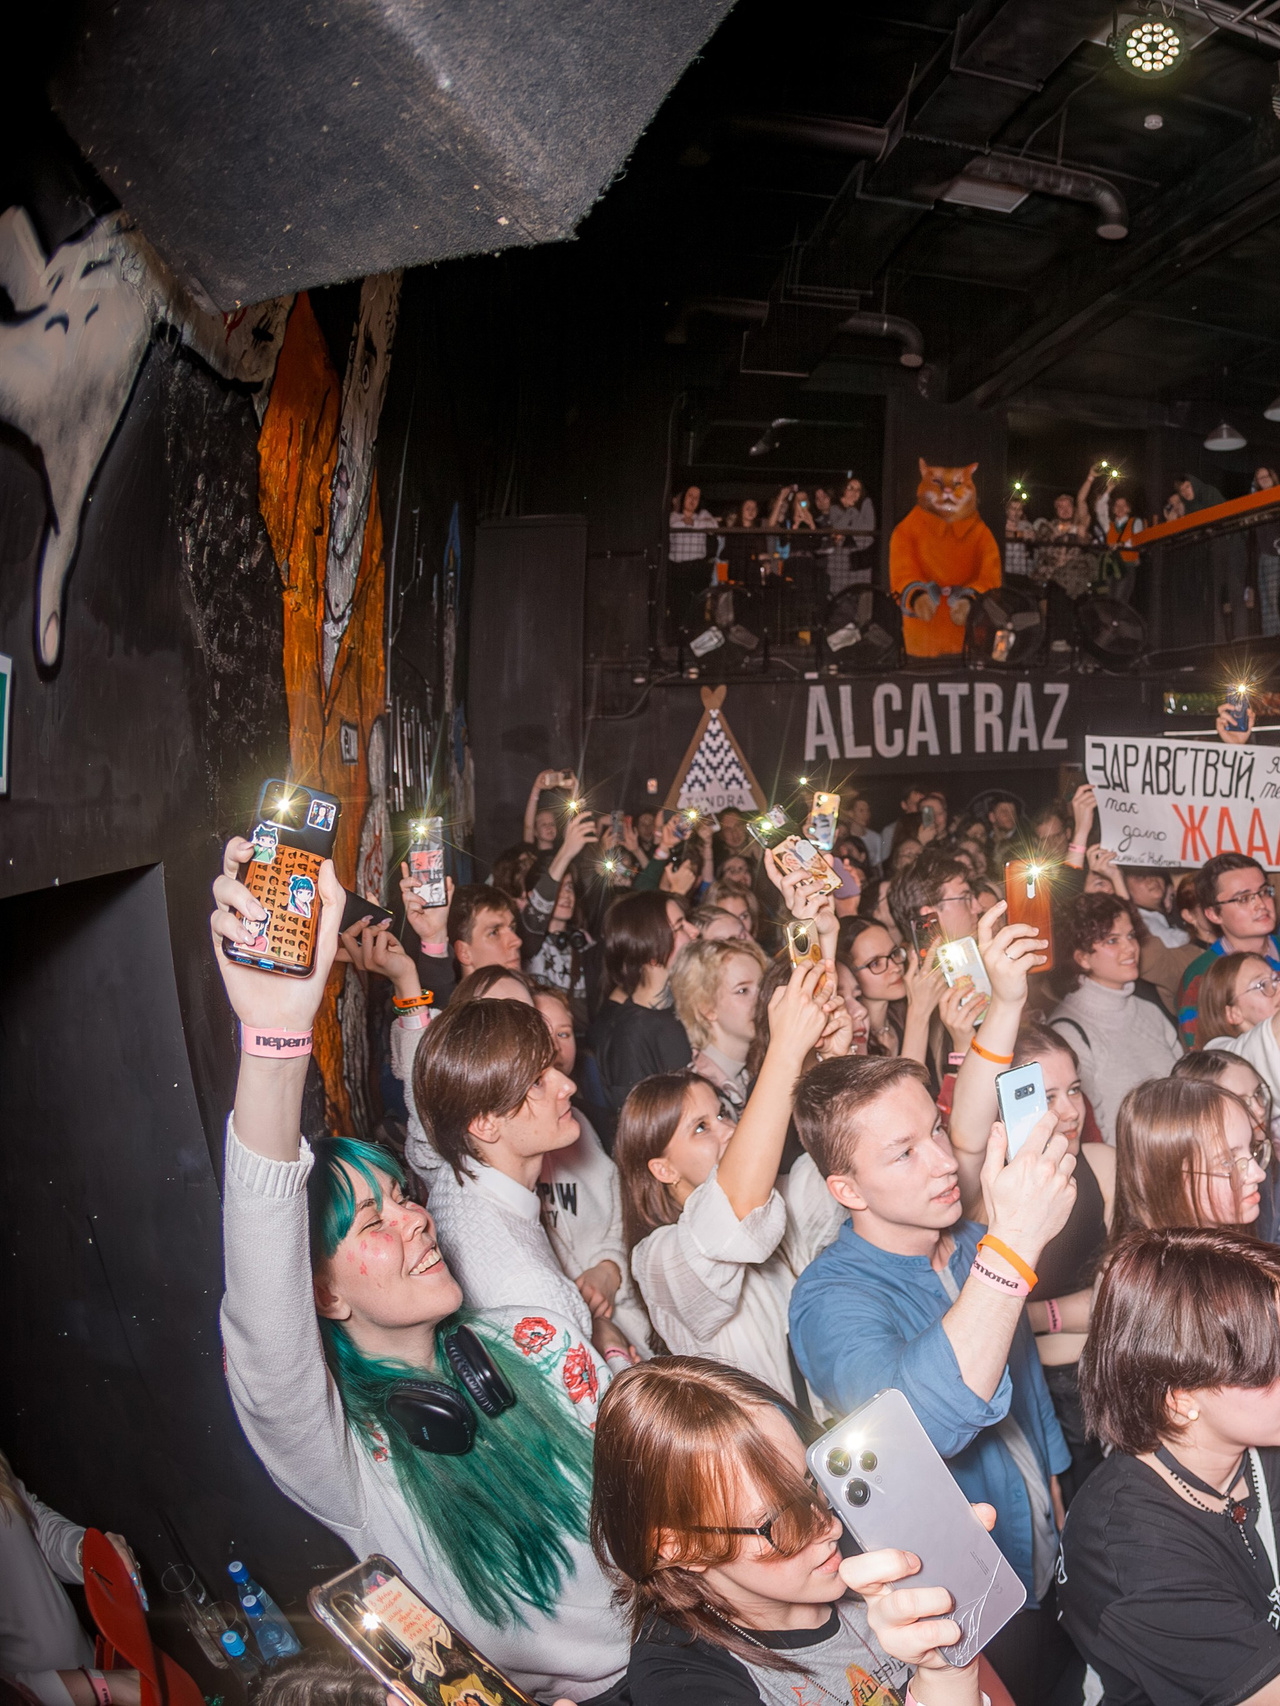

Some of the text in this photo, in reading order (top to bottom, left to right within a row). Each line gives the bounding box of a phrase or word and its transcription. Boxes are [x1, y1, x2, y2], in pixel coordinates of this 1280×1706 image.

[803, 682, 1070, 761] ALCATRAZ
[1091, 742, 1256, 803] ЗДРАВСТВУЙ,
[1105, 797, 1139, 815] так
[1118, 825, 1167, 852] долго
